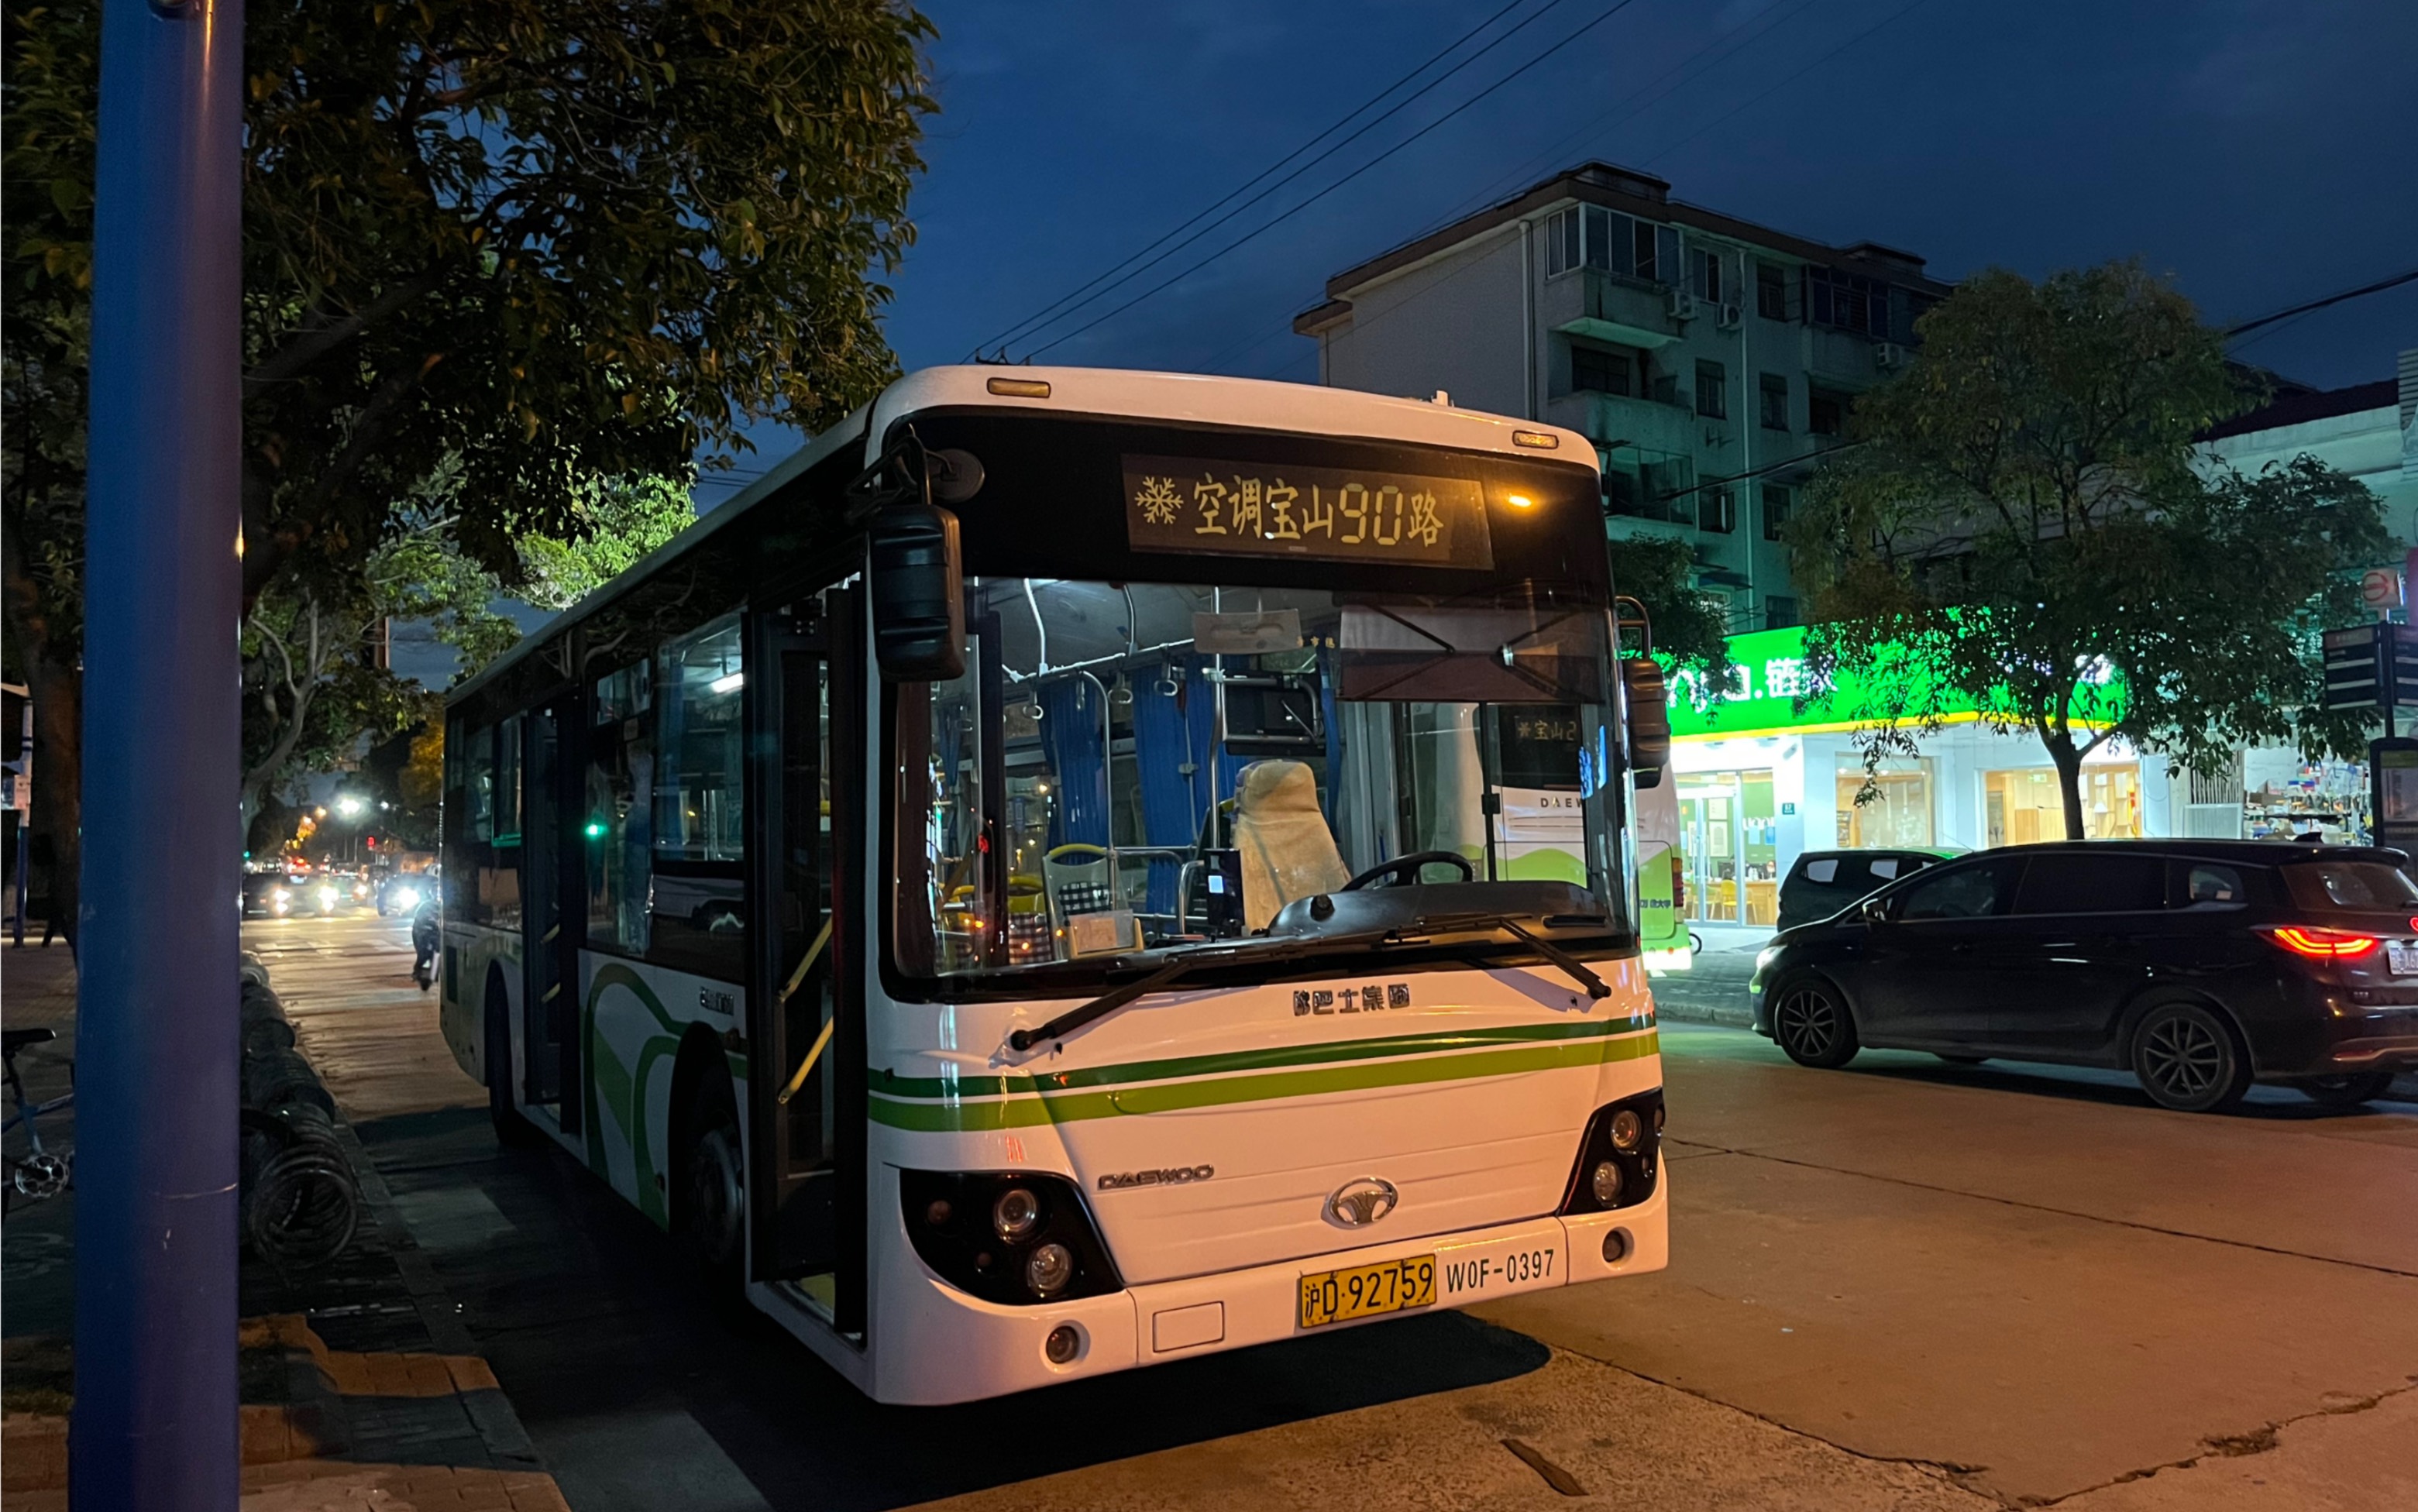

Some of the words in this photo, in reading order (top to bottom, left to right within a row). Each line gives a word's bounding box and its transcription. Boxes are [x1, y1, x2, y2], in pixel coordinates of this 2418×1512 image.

[1194, 472, 1444, 547] 空调宝山90路
[1098, 1164, 1215, 1191] DAEWOO
